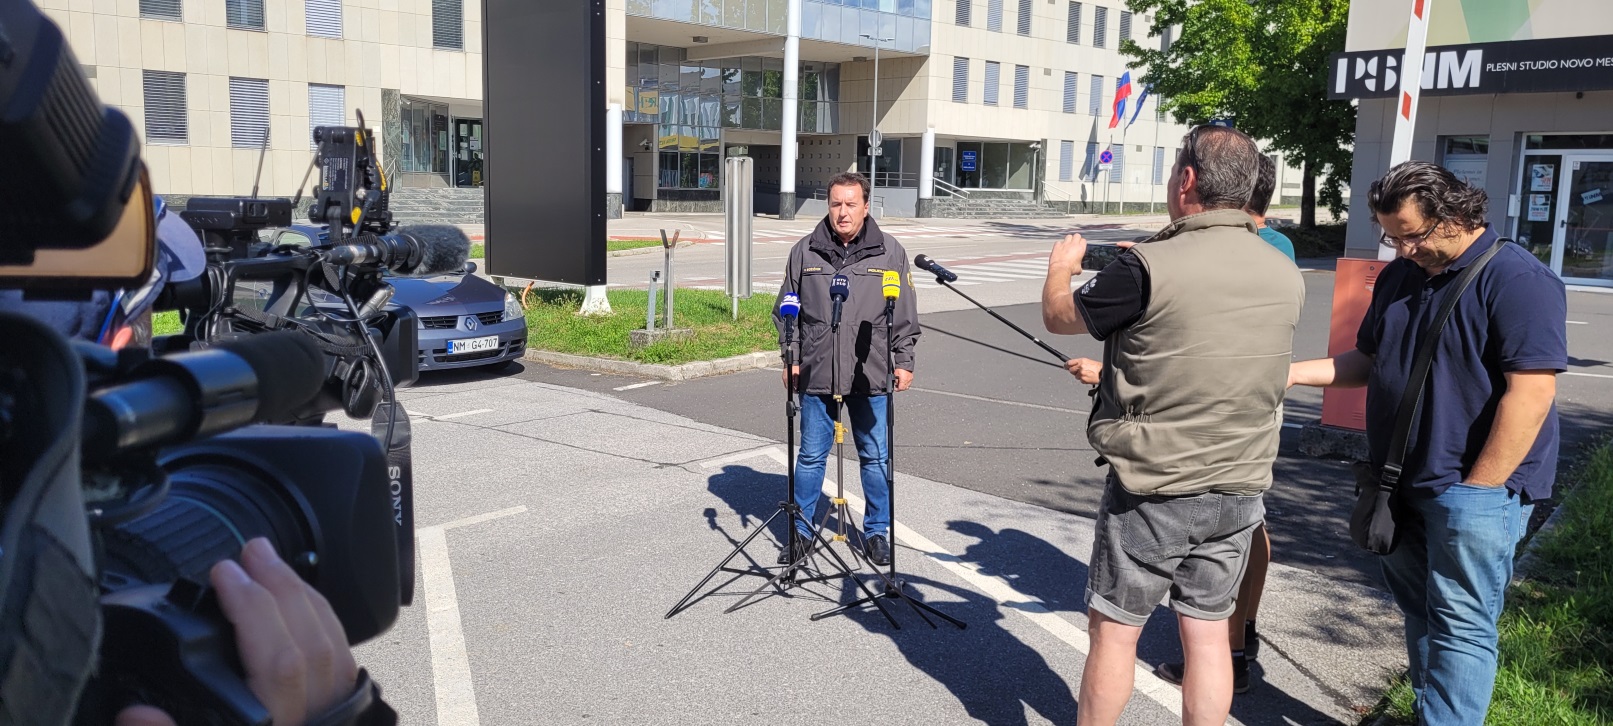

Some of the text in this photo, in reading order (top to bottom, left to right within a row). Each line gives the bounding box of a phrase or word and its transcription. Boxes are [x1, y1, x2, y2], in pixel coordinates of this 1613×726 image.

[1486, 62, 1518, 72] PLESNI
[1519, 60, 1558, 71] STUDIO
[1560, 58, 1594, 69] NOVO
[783, 294, 799, 303] 24
[453, 338, 498, 352] NM G4-707
[388, 466, 402, 526] SONY
